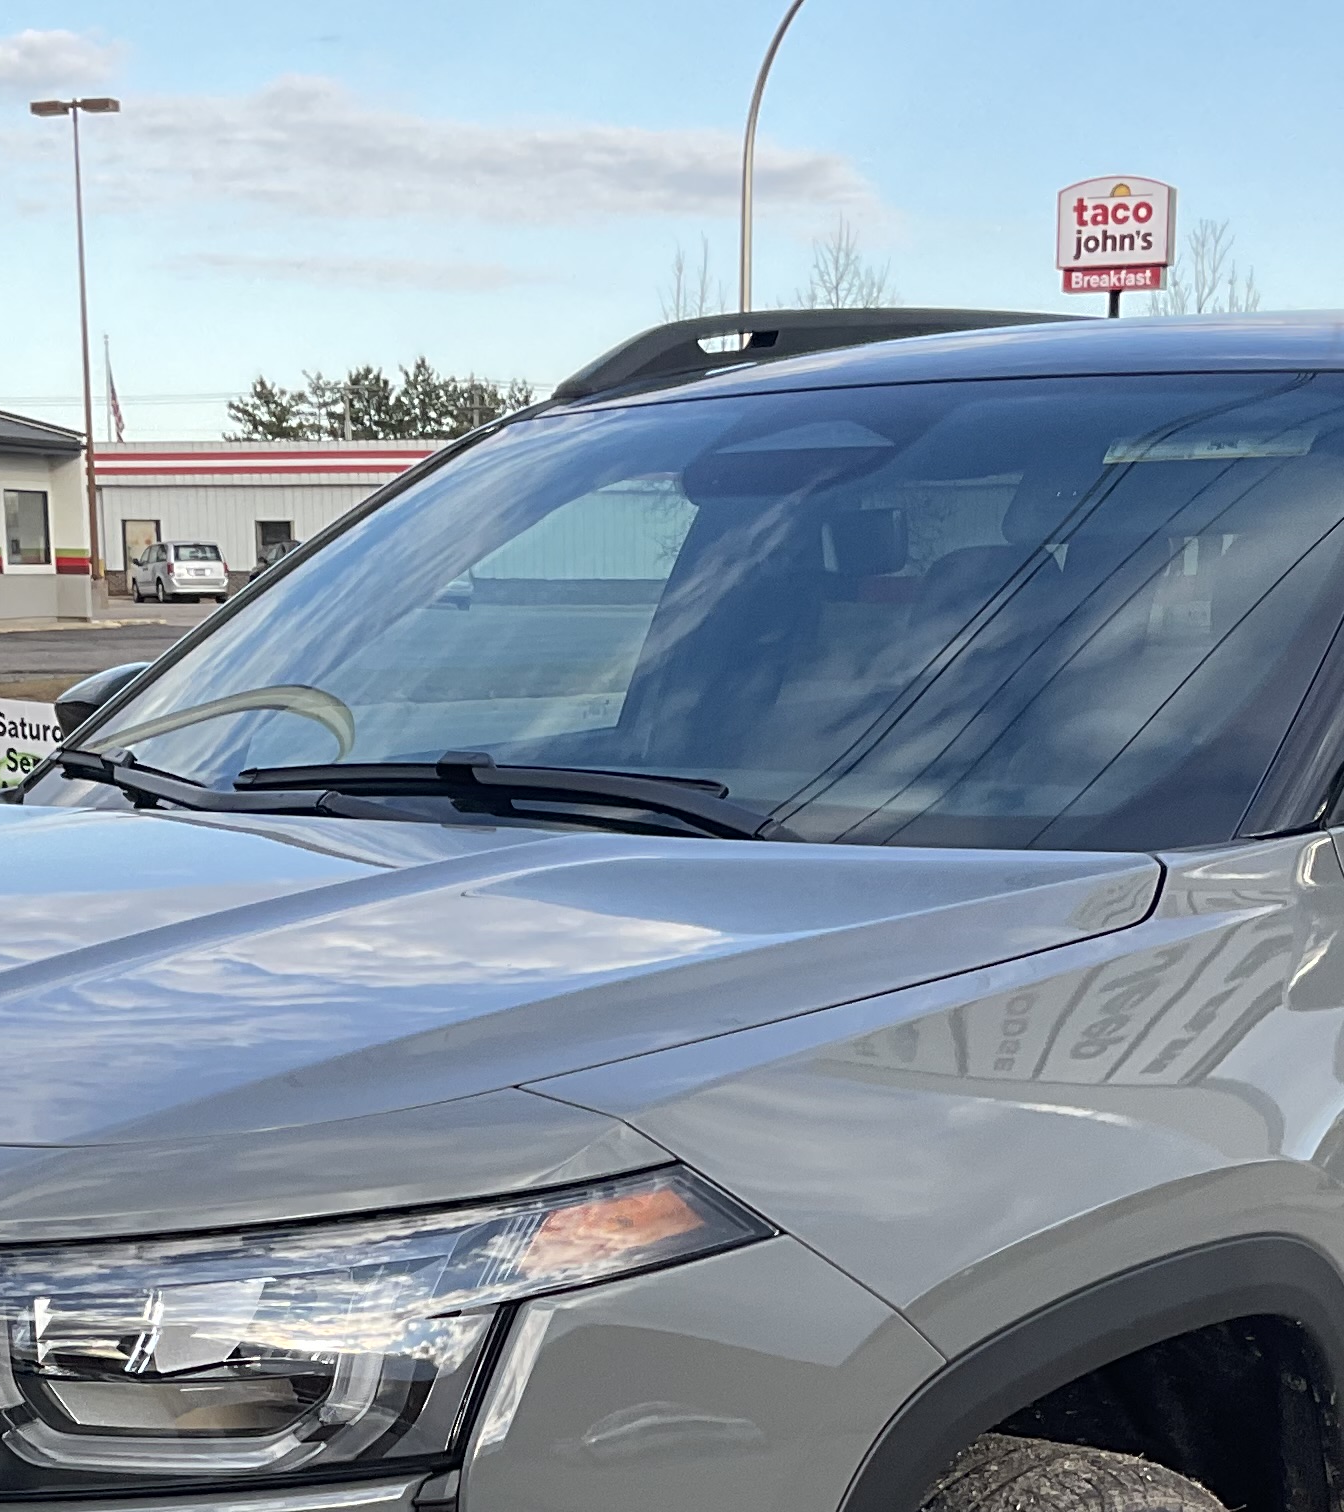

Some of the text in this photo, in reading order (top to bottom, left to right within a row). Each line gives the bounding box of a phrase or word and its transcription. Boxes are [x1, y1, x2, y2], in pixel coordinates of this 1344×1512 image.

[1073, 198, 1153, 227] taco
[1073, 229, 1153, 260] john's
[1071, 269, 1151, 289] Breakfast
